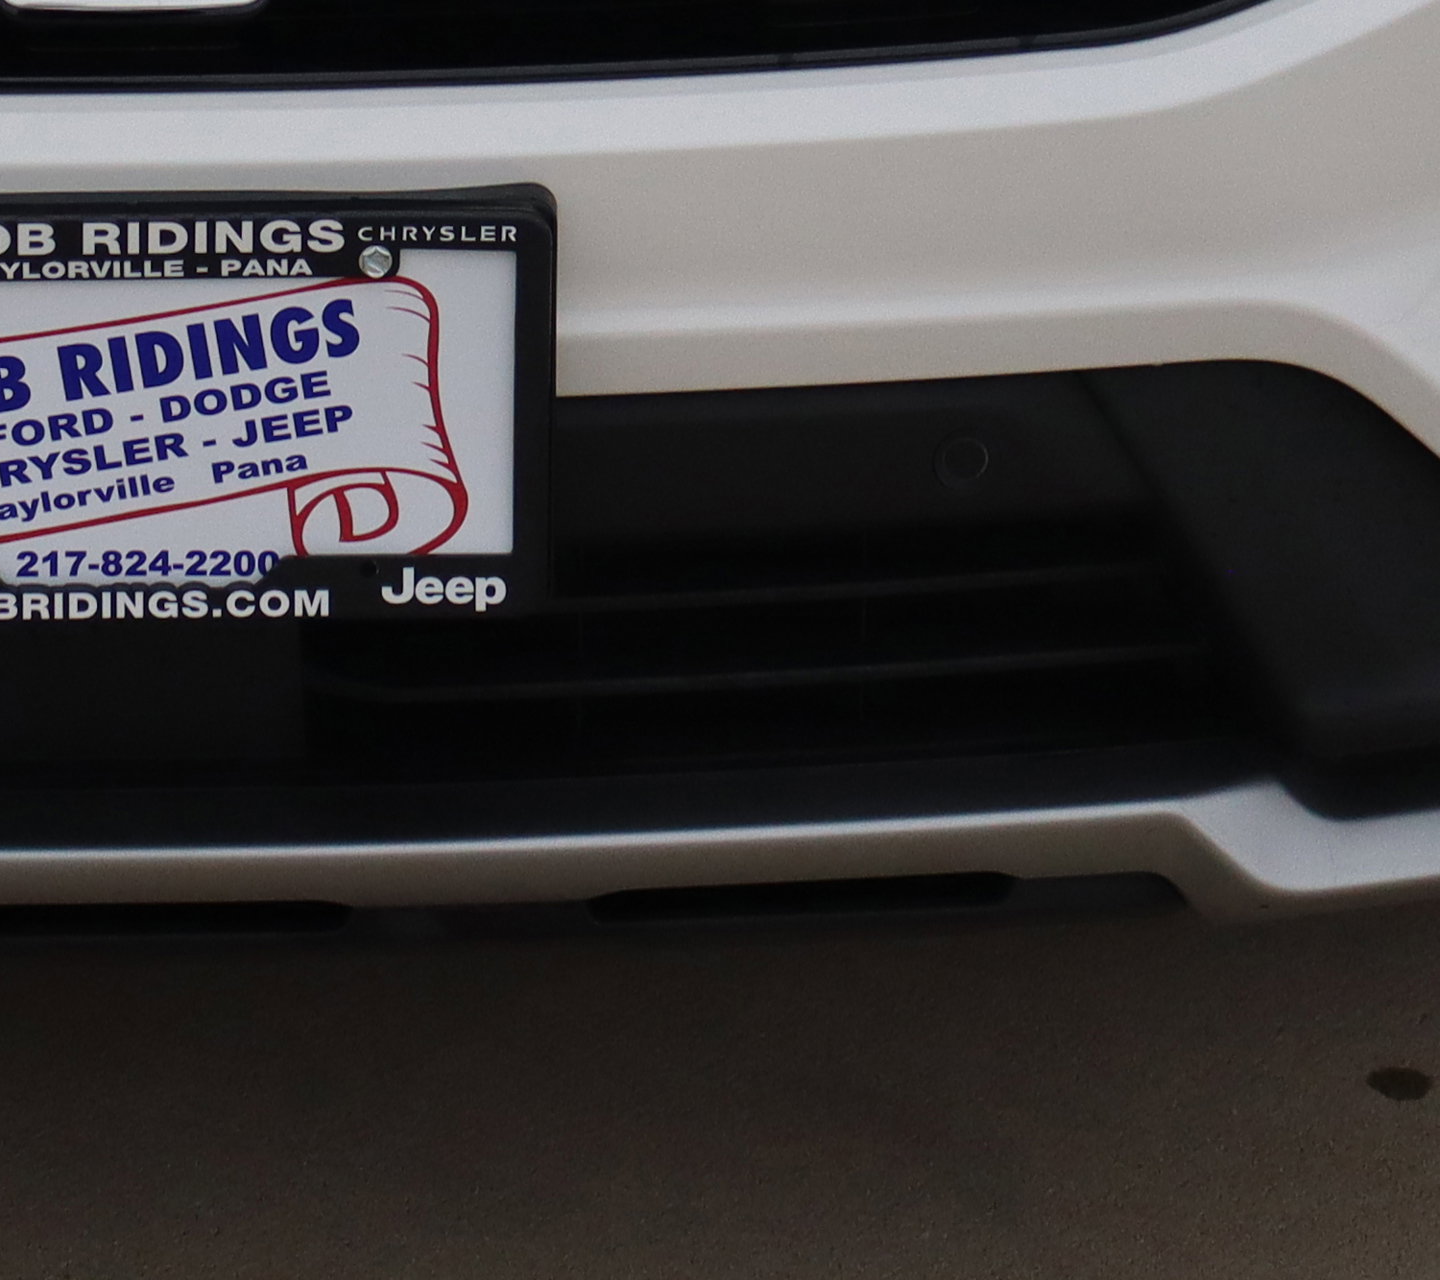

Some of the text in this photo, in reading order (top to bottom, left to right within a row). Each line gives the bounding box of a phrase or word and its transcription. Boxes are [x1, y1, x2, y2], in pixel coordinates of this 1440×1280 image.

[82, 219, 345, 256] RIDINGS
[357, 225, 518, 242] CHRYSLER
[221, 258, 313, 277] PANA
[57, 298, 361, 401] RIDINGS
[159, 370, 331, 423] DODGE
[232, 404, 353, 448] JEEP
[211, 453, 308, 484] Pana
[16, 550, 281, 578] 217-824-2200
[381, 567, 507, 612] Jeep
